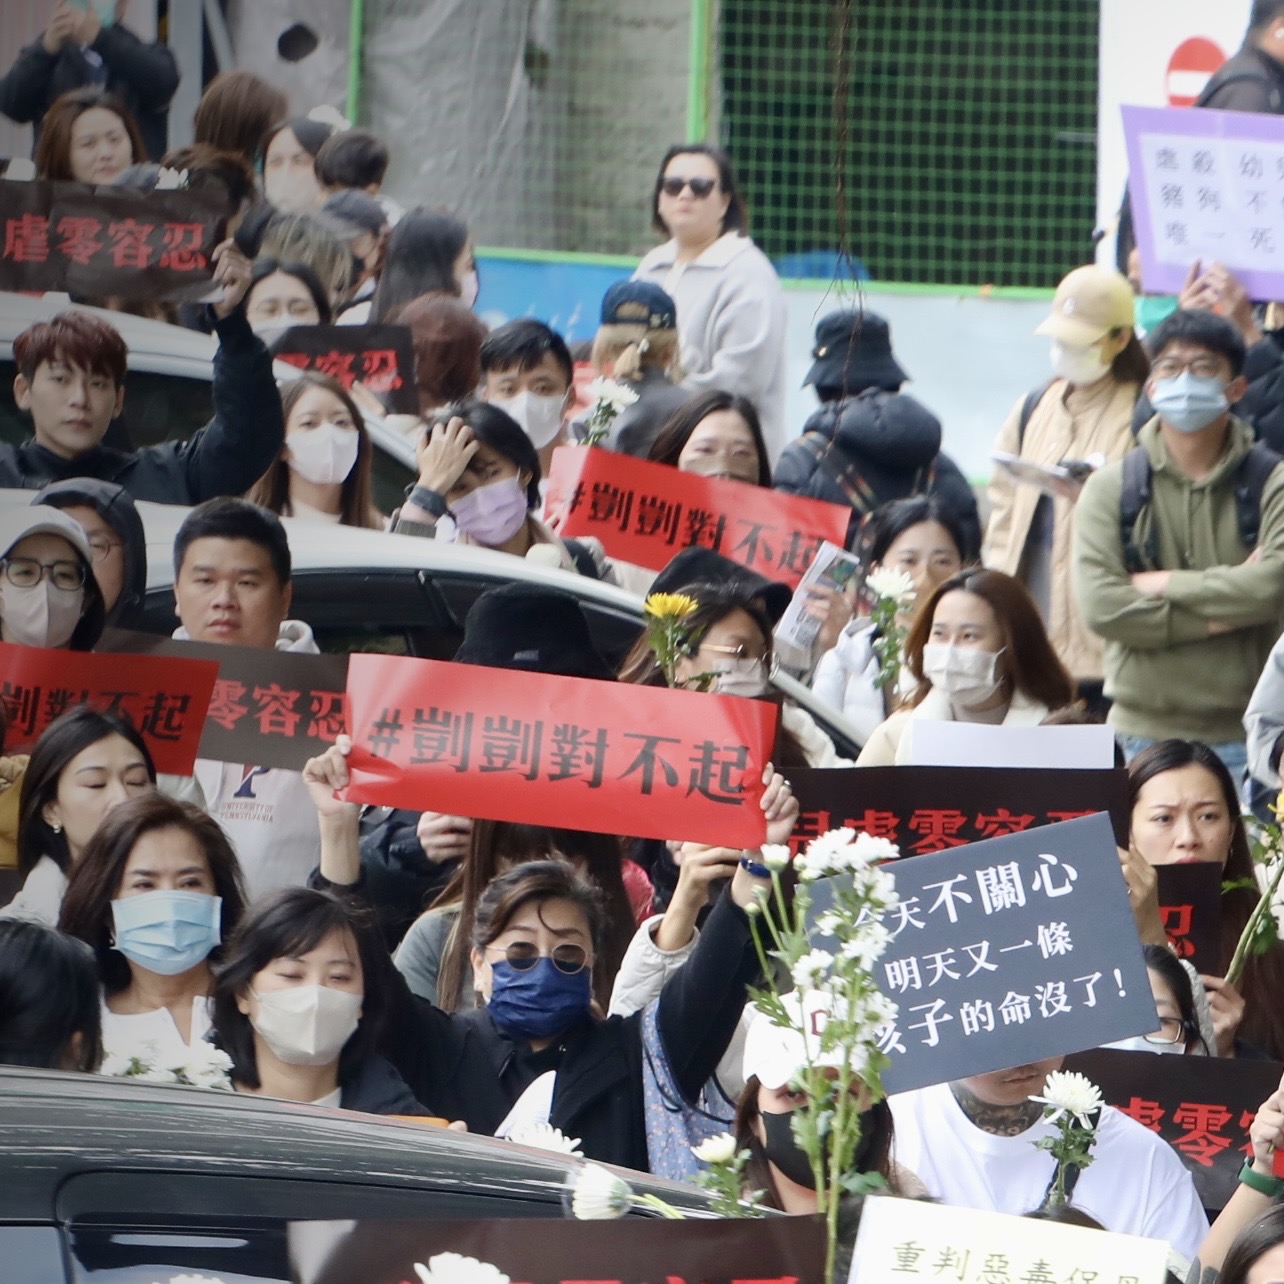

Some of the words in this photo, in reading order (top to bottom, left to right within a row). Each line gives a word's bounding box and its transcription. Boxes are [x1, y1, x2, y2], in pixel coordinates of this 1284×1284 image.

[2, 213, 208, 271] 虐零容忍
[209, 678, 347, 743] 零容忍
[367, 706, 751, 806] #剴剴對不起
[884, 921, 1075, 994] 明天又一條
